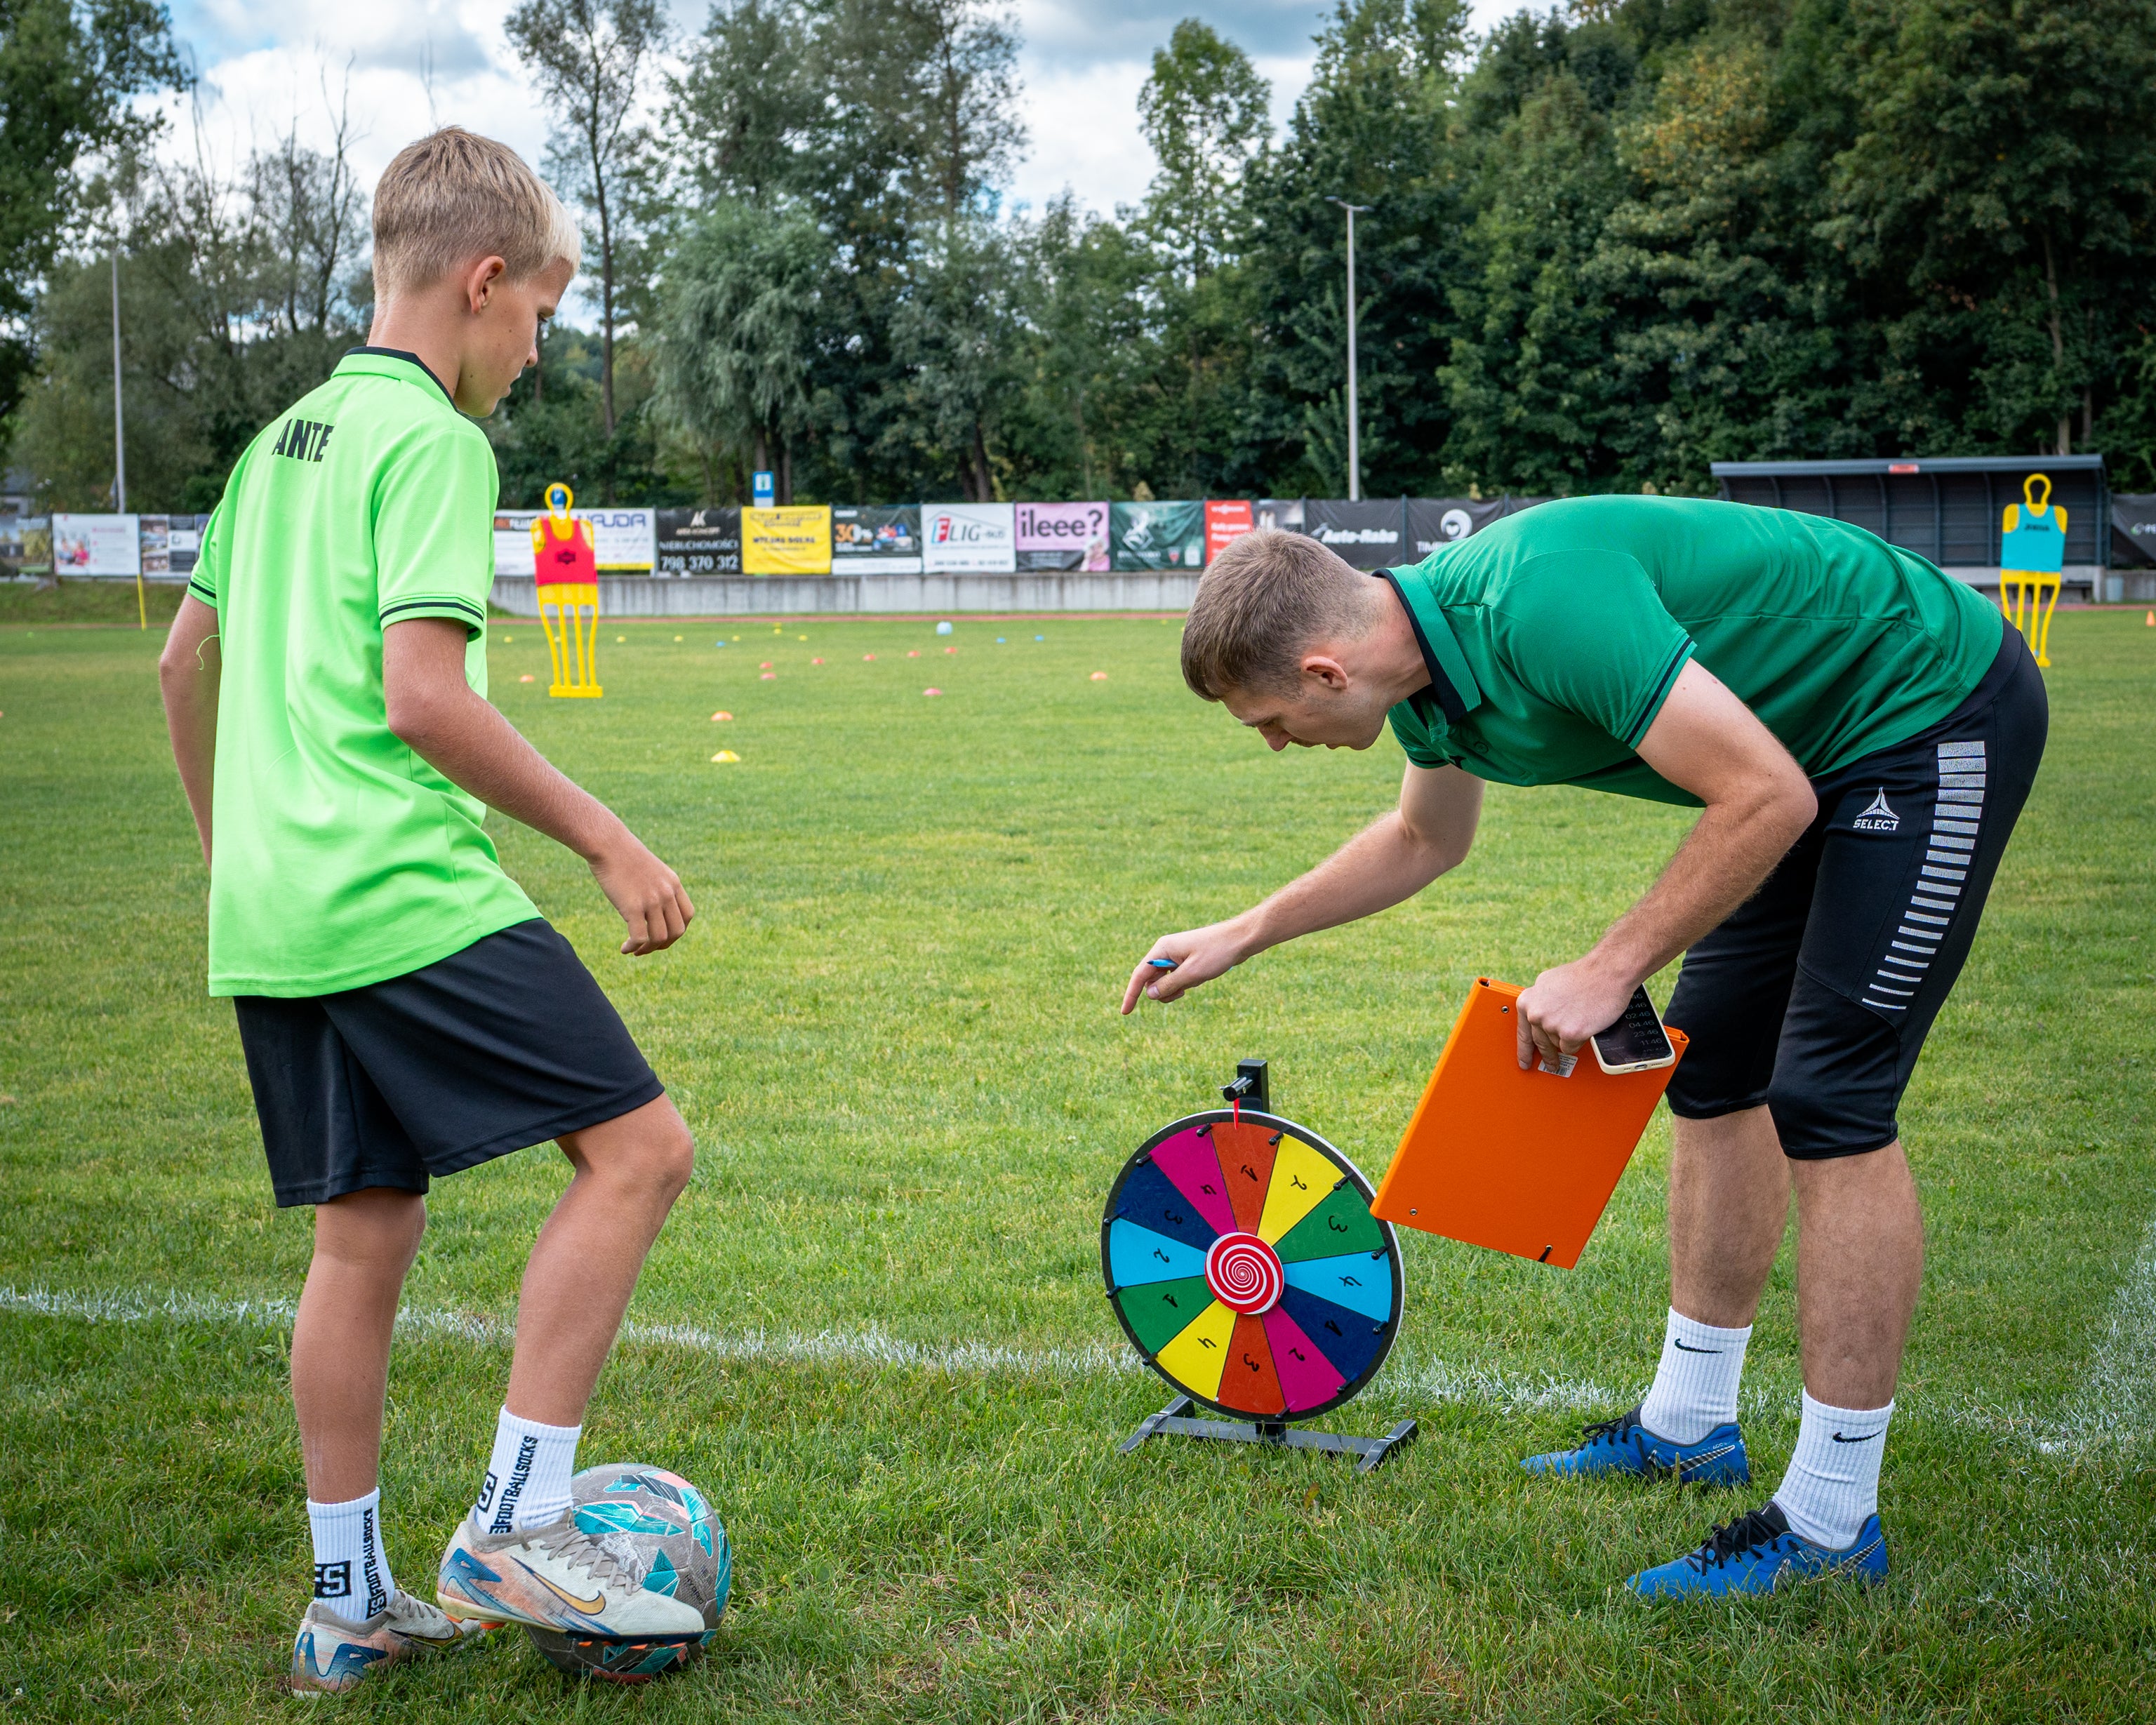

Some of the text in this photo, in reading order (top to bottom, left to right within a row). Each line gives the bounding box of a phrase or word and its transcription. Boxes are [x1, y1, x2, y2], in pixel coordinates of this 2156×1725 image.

[272, 418, 335, 462] ANTE
[1021, 509, 1103, 537] ileee?
[688, 554, 714, 571] 370
[717, 554, 738, 571] 312
[1853, 819, 1899, 831] SELECT
[1329, 1216, 1348, 1232] 3
[494, 1435, 538, 1525] FOOTBALLSOCKS
[364, 1507, 385, 1598] FOOTBALLSOCKS
